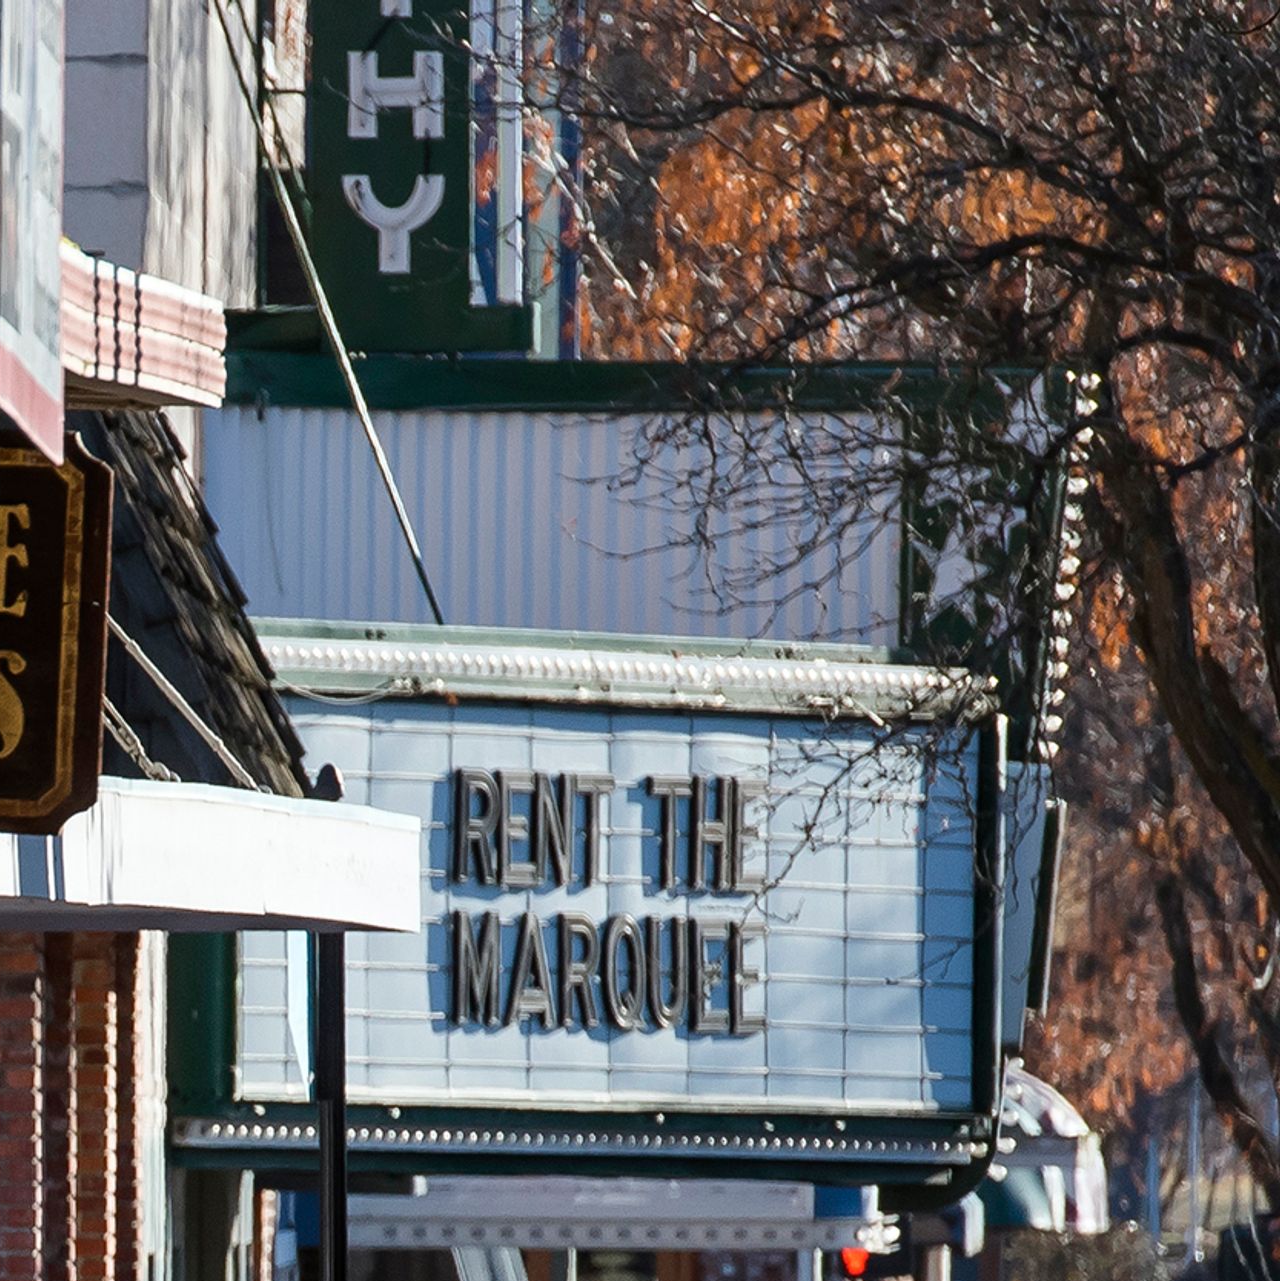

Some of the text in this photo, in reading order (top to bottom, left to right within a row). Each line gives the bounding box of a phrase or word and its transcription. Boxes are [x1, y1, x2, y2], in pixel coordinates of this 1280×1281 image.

[342, 0, 445, 274] HY
[451, 766, 769, 891] RENT THE
[450, 910, 768, 1036] MARQUEE
